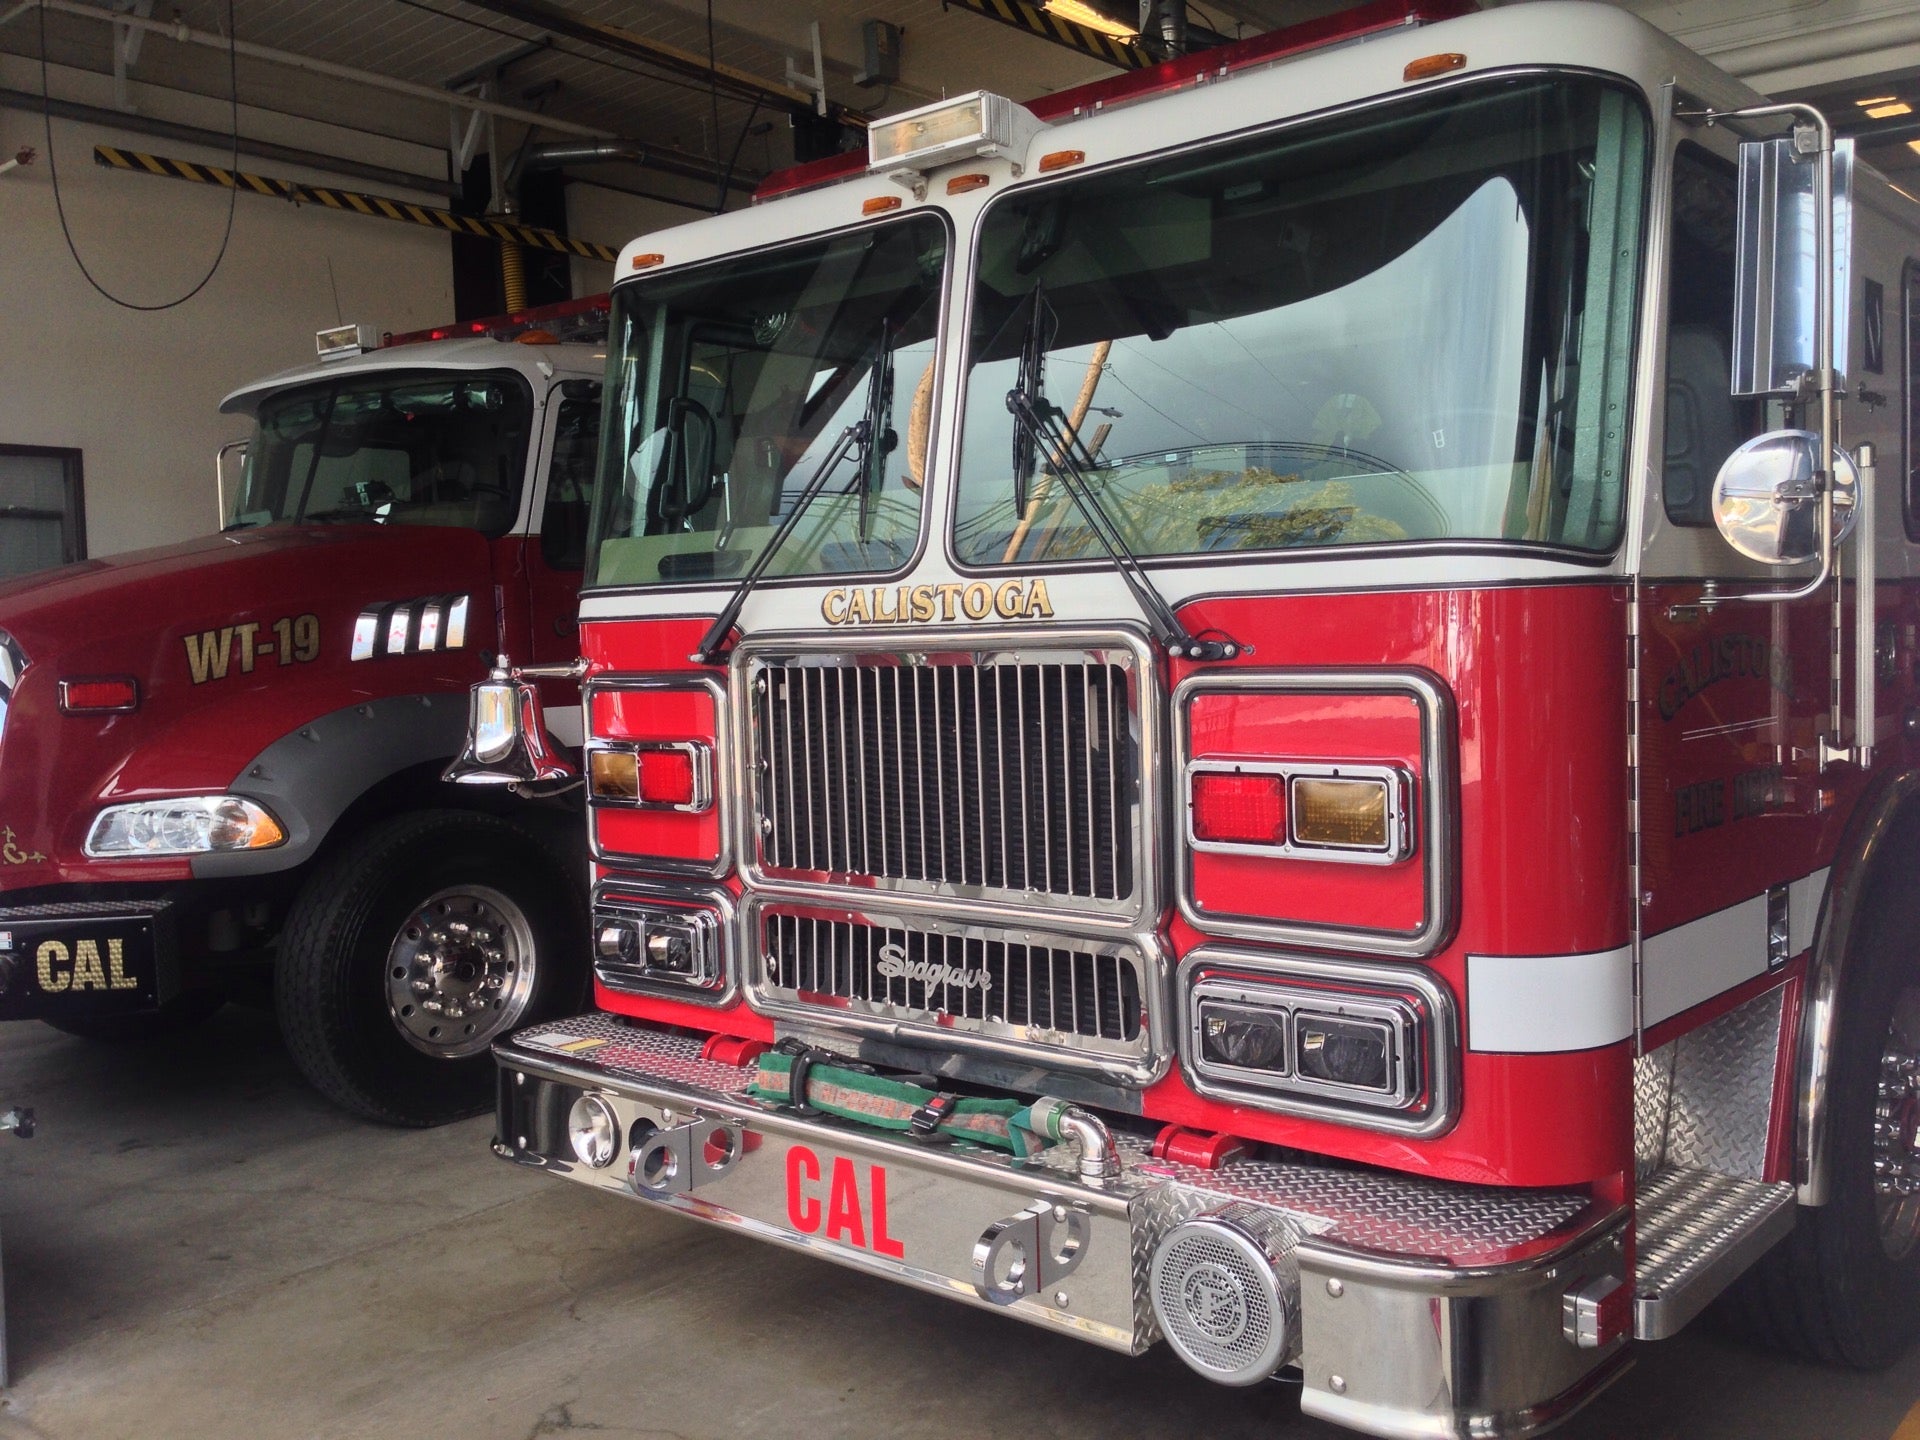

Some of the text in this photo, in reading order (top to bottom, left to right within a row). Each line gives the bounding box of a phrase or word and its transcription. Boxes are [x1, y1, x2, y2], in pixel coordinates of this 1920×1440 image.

[821, 579, 1055, 625] CALISTOGA
[183, 613, 320, 685] WT-19
[36, 938, 138, 993] CAL
[877, 943, 992, 998] Seagrave
[785, 1144, 905, 1259] CAL
